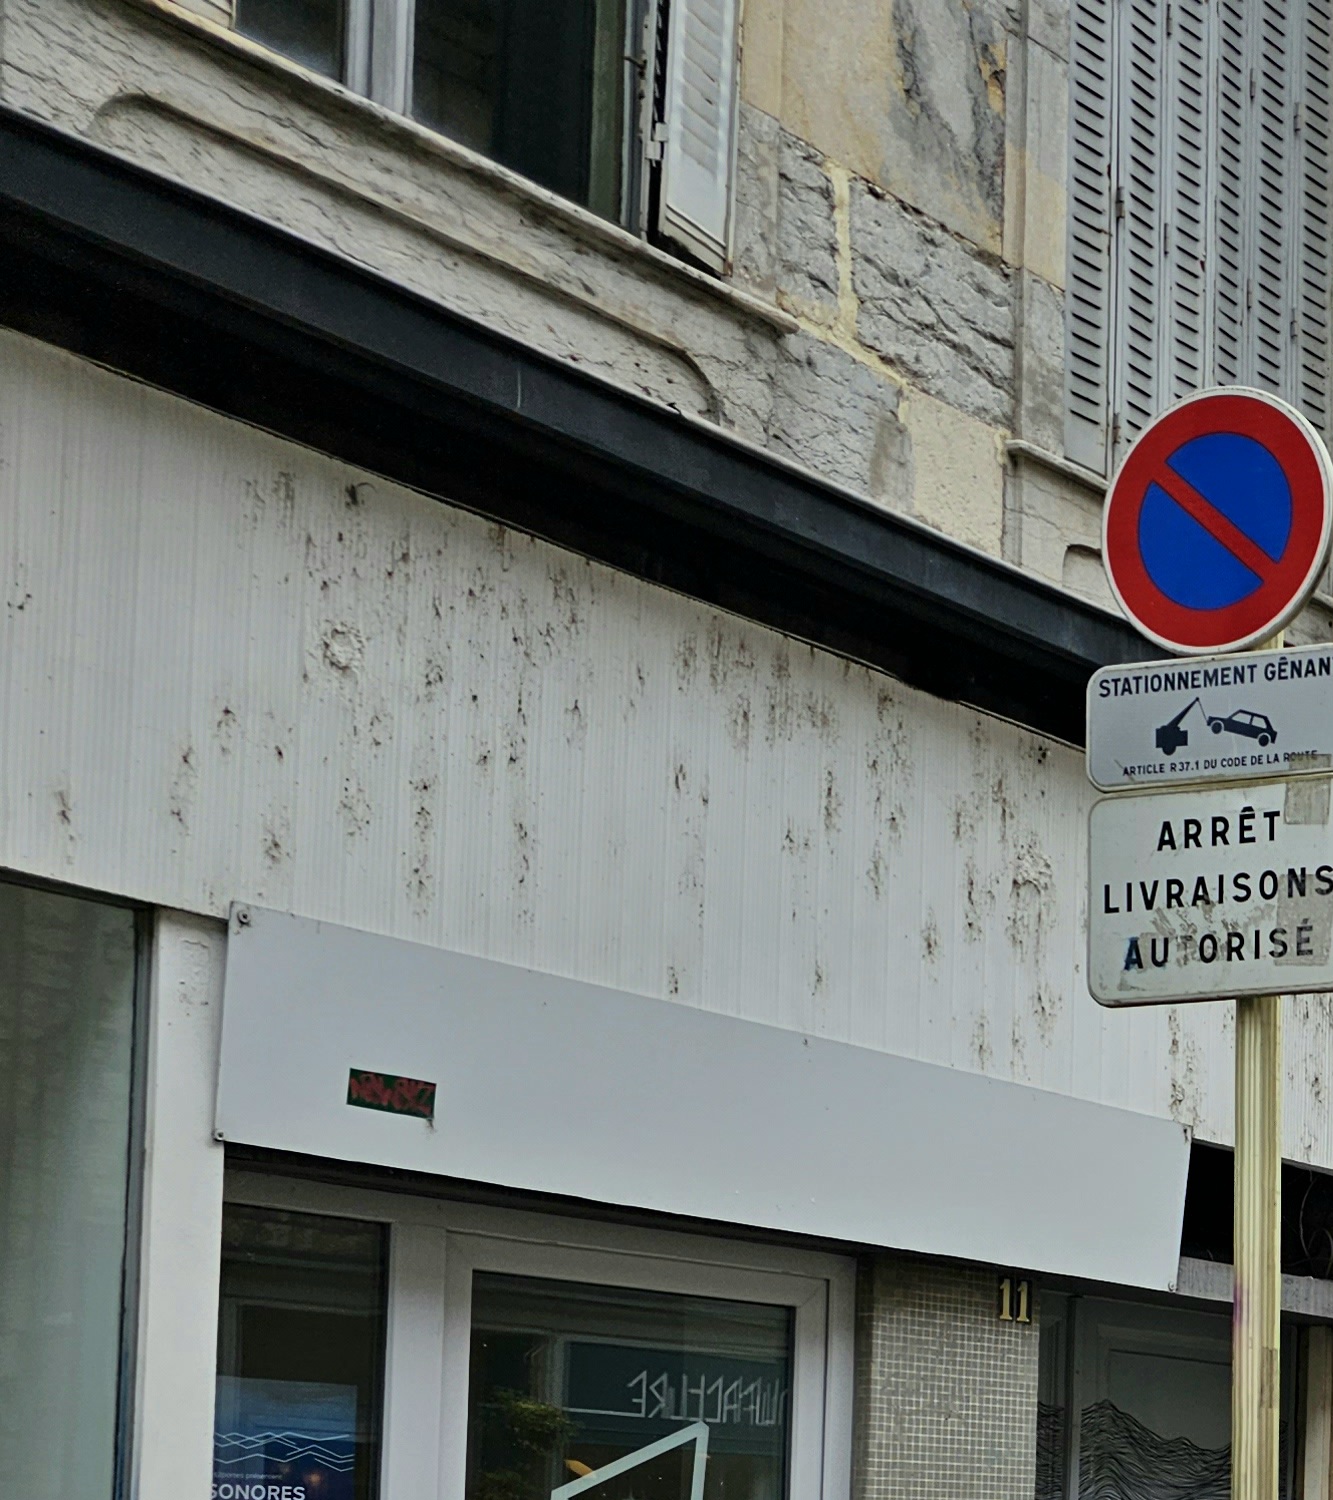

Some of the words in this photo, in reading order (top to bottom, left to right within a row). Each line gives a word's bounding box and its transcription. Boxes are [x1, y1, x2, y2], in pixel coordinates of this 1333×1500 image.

[1099, 664, 1258, 698] STATIONNEMENT
[1122, 763, 1166, 777] ARTICLE
[1203, 759, 1217, 770] DU
[1221, 756, 1247, 768] CODE
[1250, 755, 1264, 766] DE
[1266, 754, 1280, 764] LA
[1156, 805, 1281, 852] ARRÊT
[1000, 1278, 1030, 1322] 11
